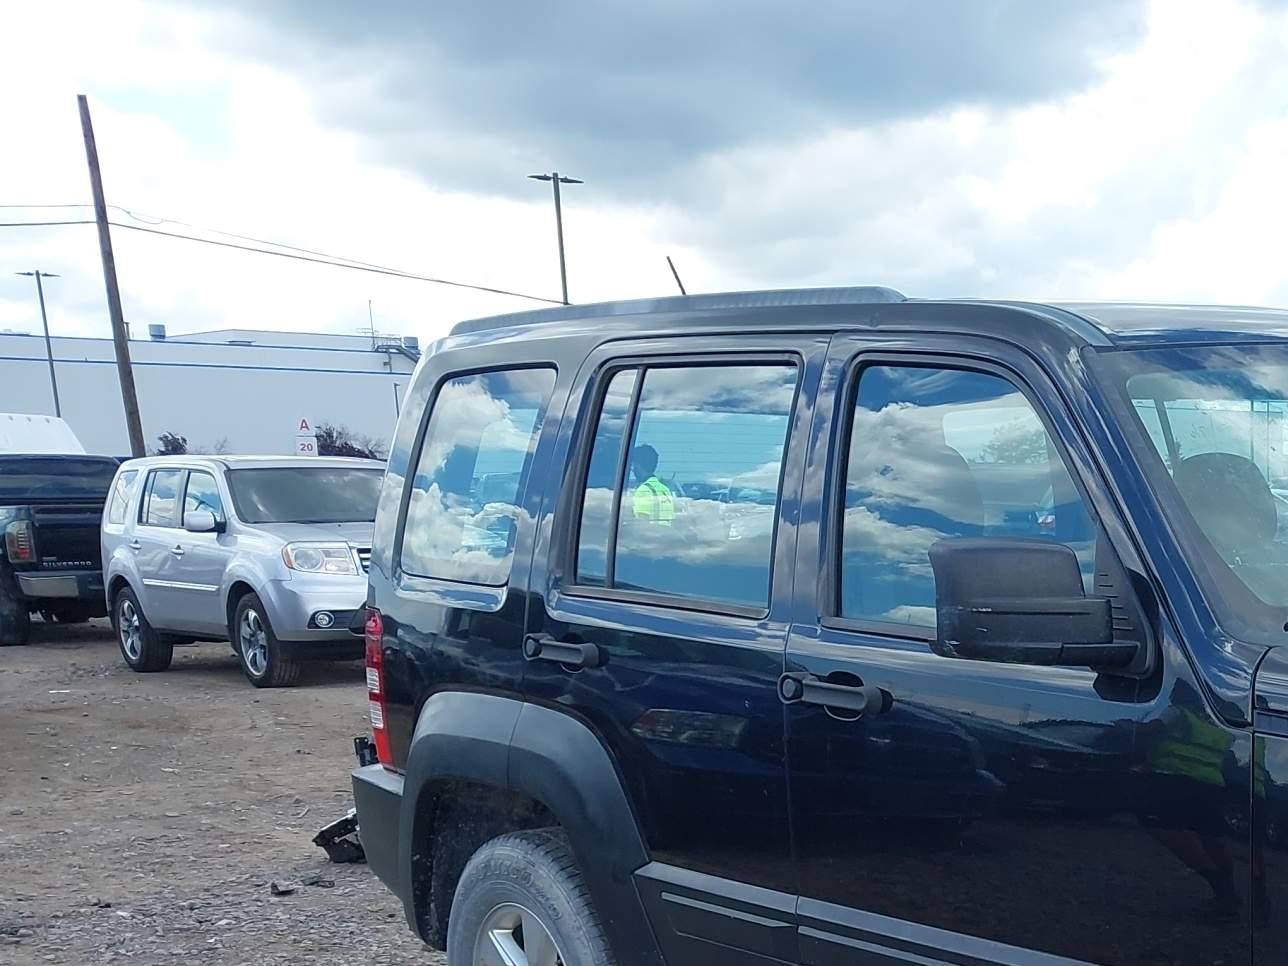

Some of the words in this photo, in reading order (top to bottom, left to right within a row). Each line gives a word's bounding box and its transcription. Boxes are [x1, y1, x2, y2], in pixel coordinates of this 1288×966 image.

[299, 418, 310, 431] A
[299, 443, 313, 452] 20
[42, 560, 92, 568] SILVERADO
